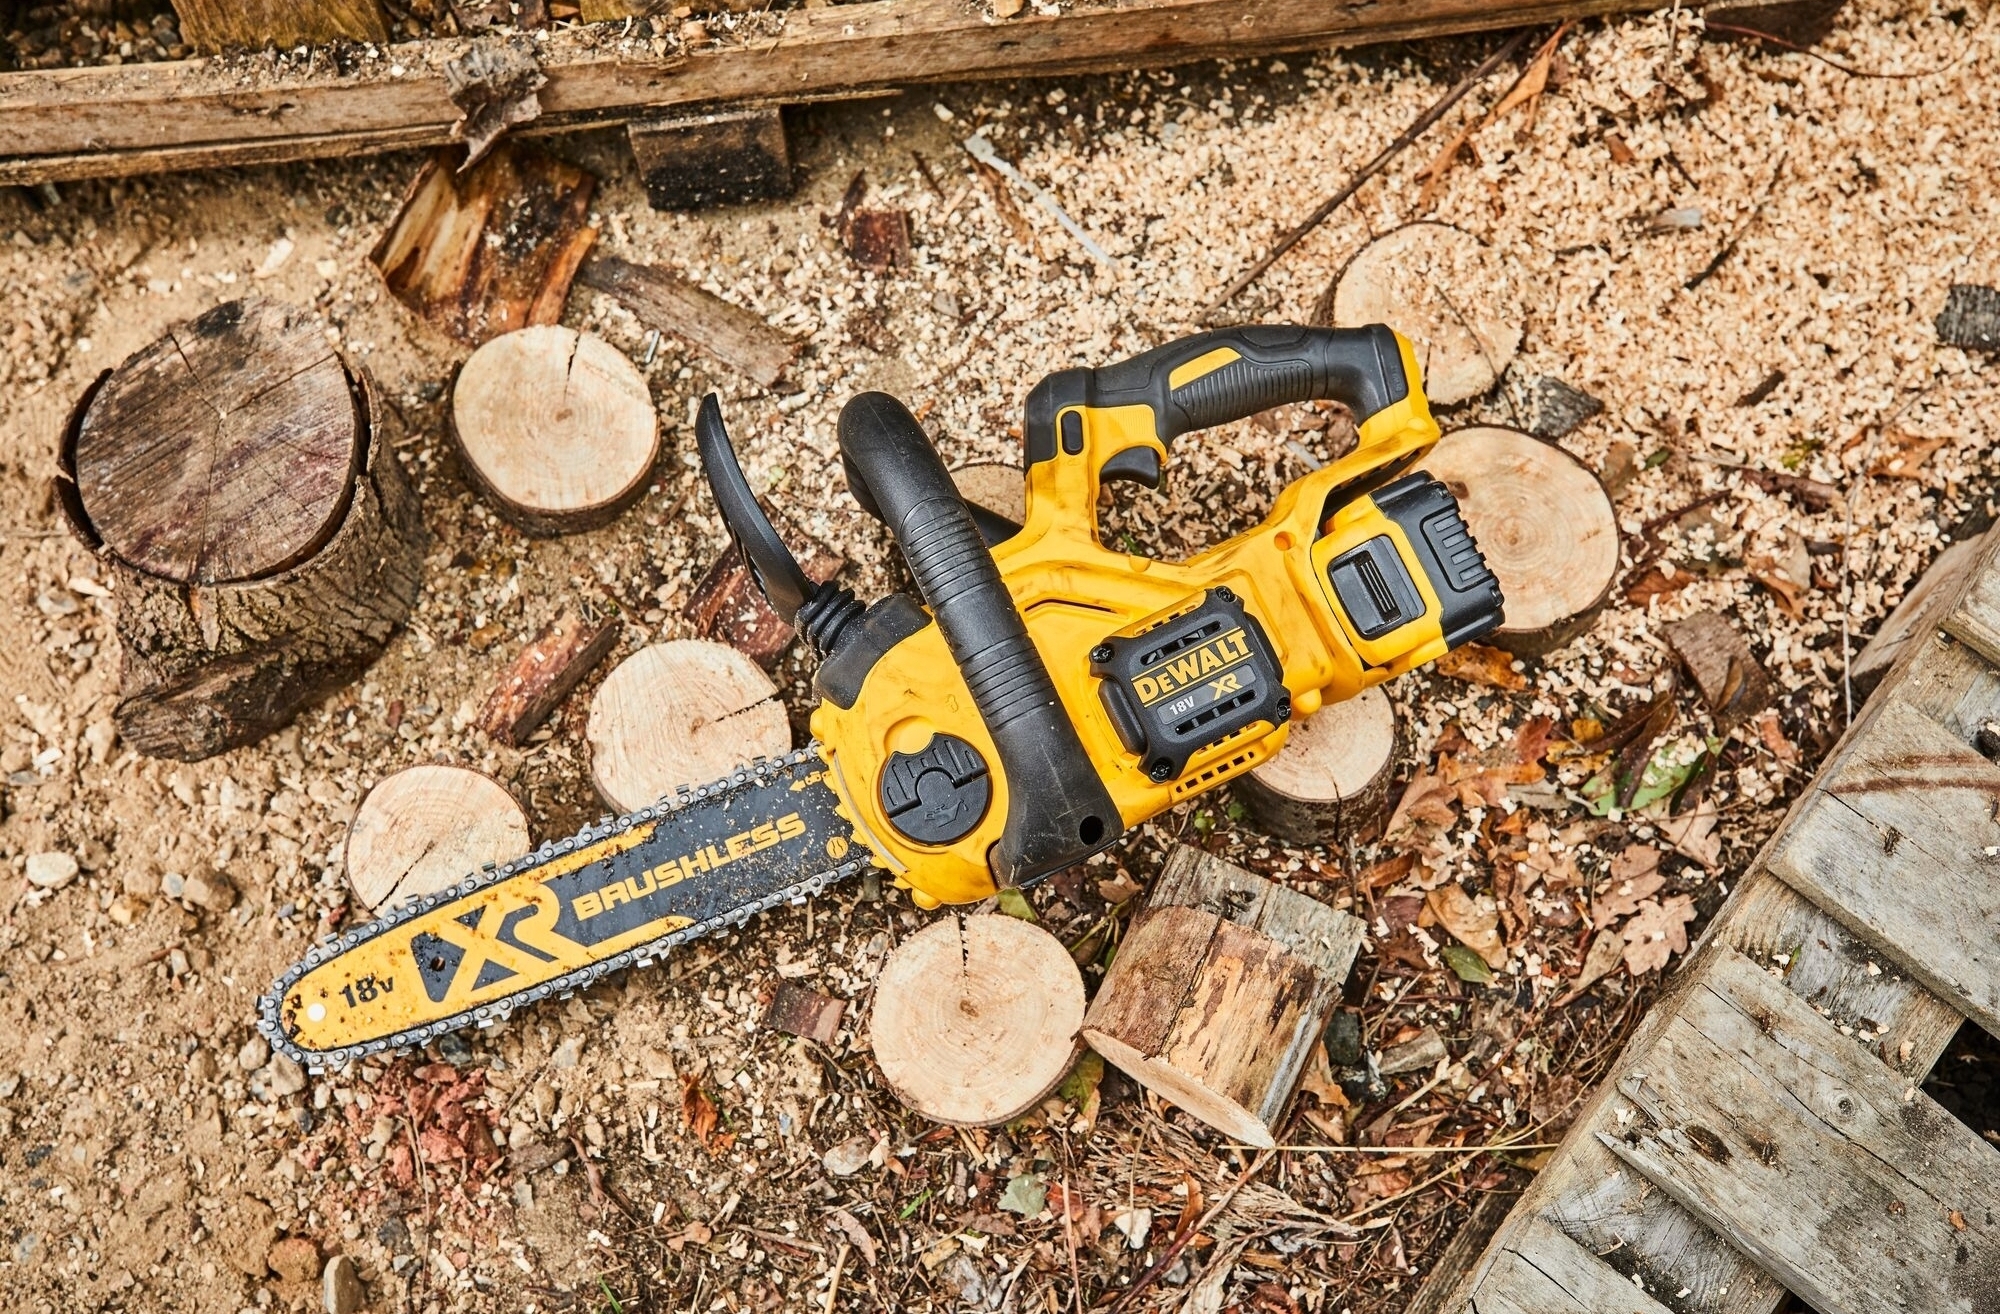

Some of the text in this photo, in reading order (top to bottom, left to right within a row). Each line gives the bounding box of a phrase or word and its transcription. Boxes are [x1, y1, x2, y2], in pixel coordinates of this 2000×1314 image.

[1169, 673, 1243, 716] 18V XR
[424, 881, 590, 1003] XR
[571, 812, 807, 922] BRUSHLESS
